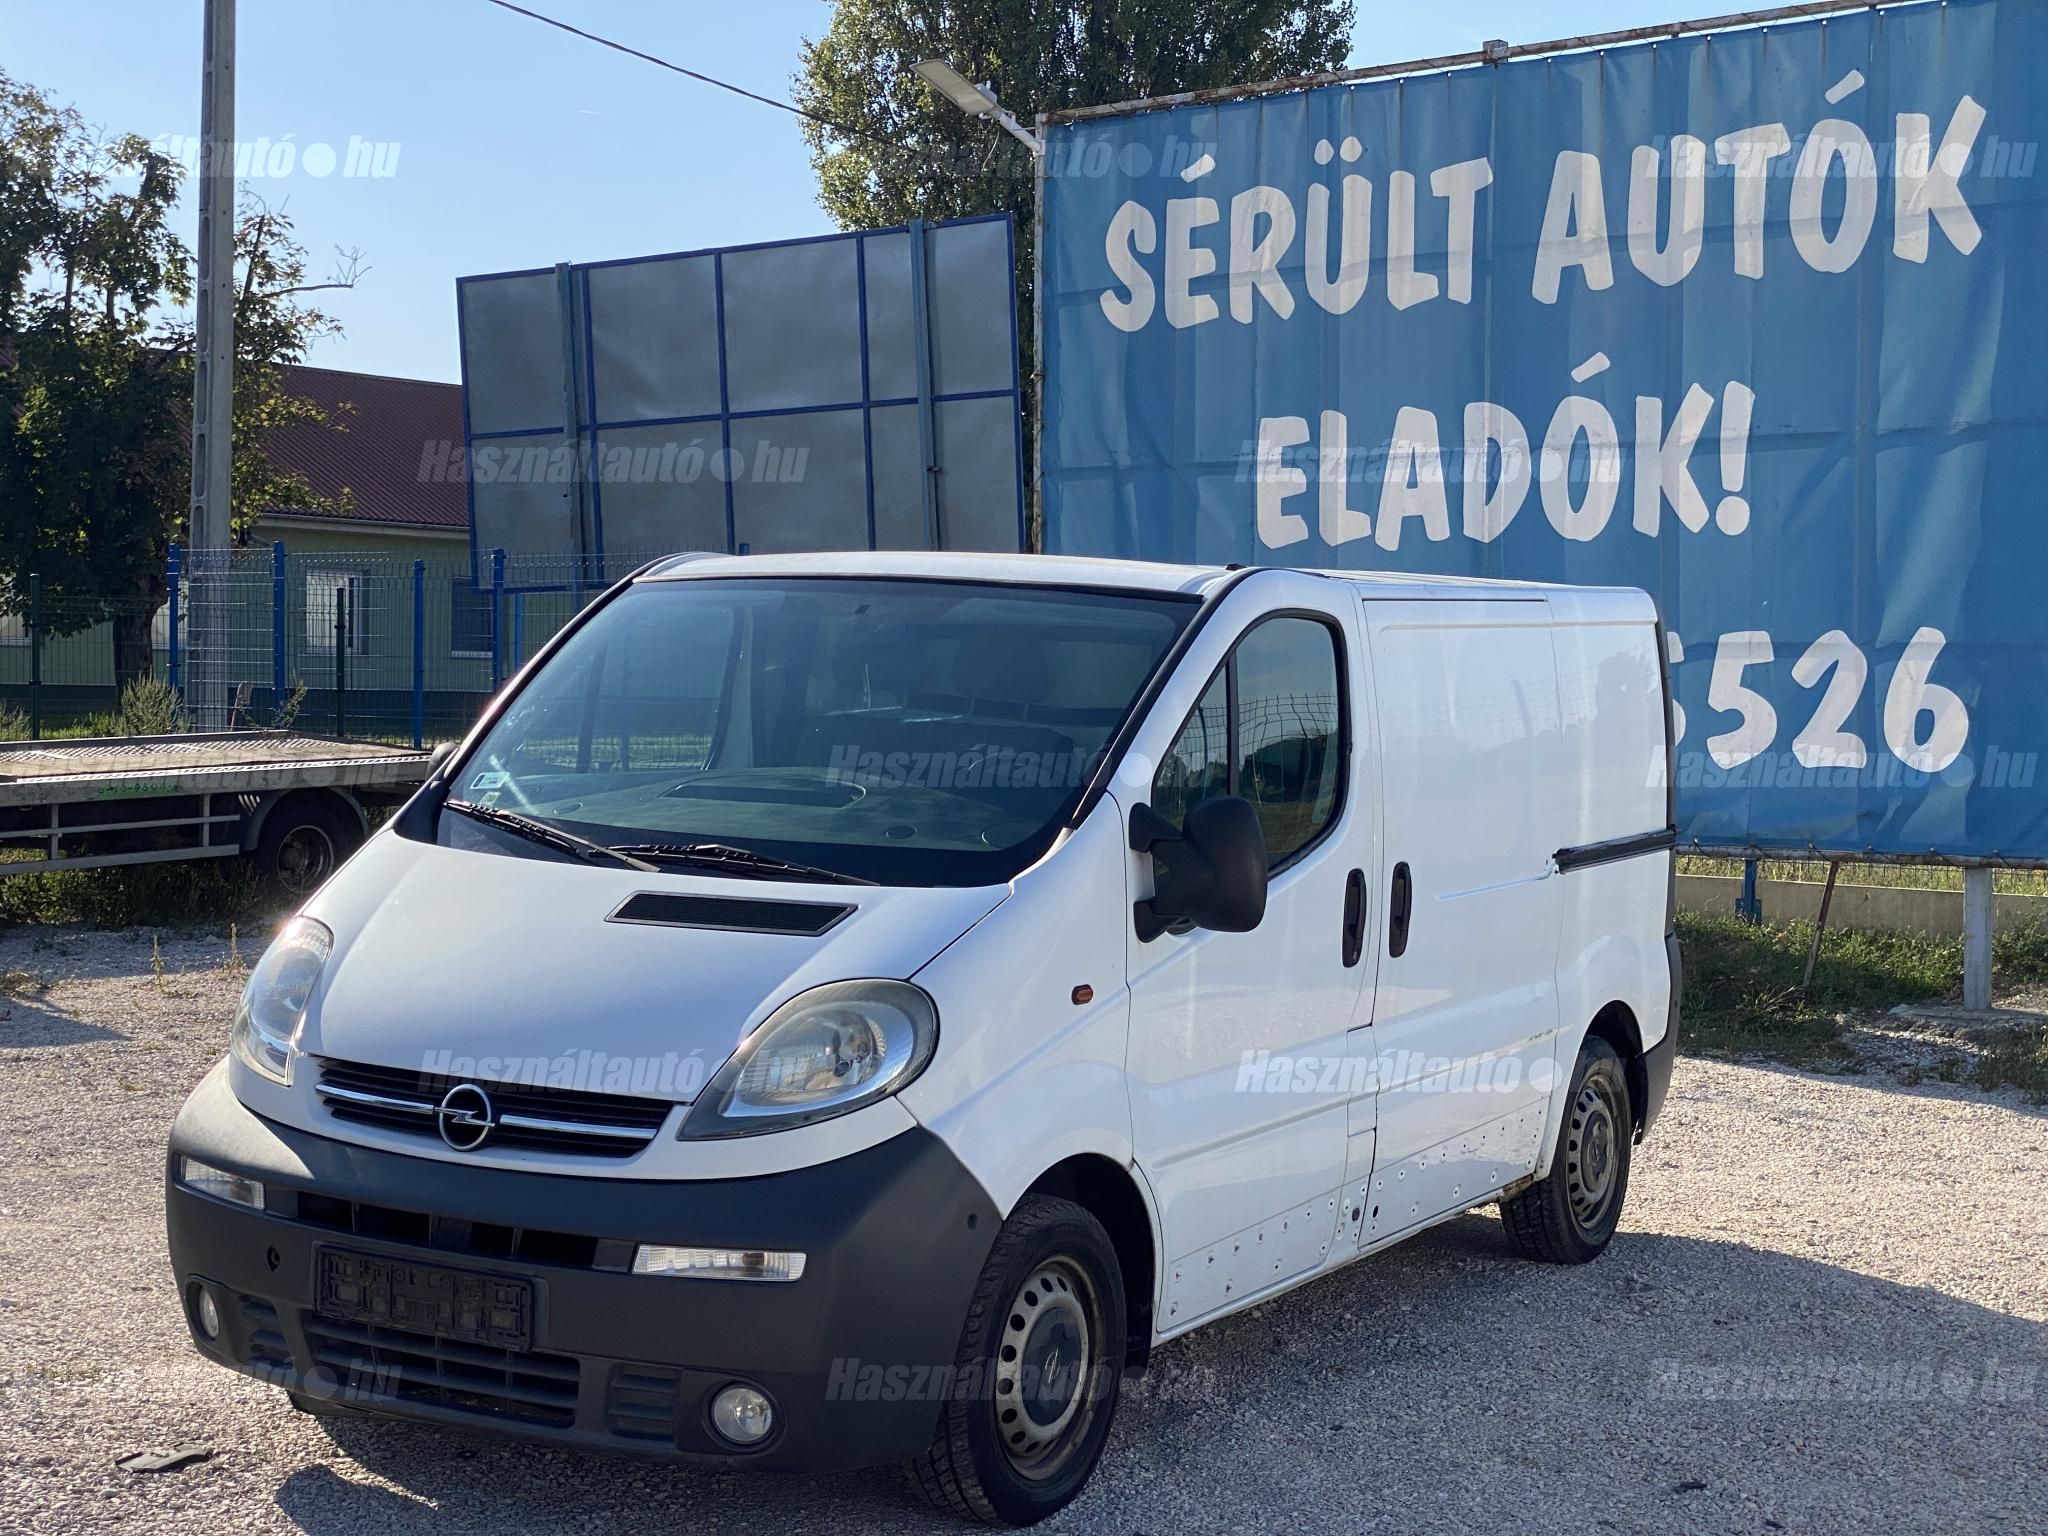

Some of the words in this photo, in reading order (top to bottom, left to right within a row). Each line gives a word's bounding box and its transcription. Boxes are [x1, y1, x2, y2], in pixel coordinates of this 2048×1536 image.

[1100, 136, 1493, 332] SÉRÜLT
[1532, 69, 1987, 304] AUTÓK
[1257, 352, 1756, 551] ELADÓK!
[1667, 627, 1969, 772] 526
